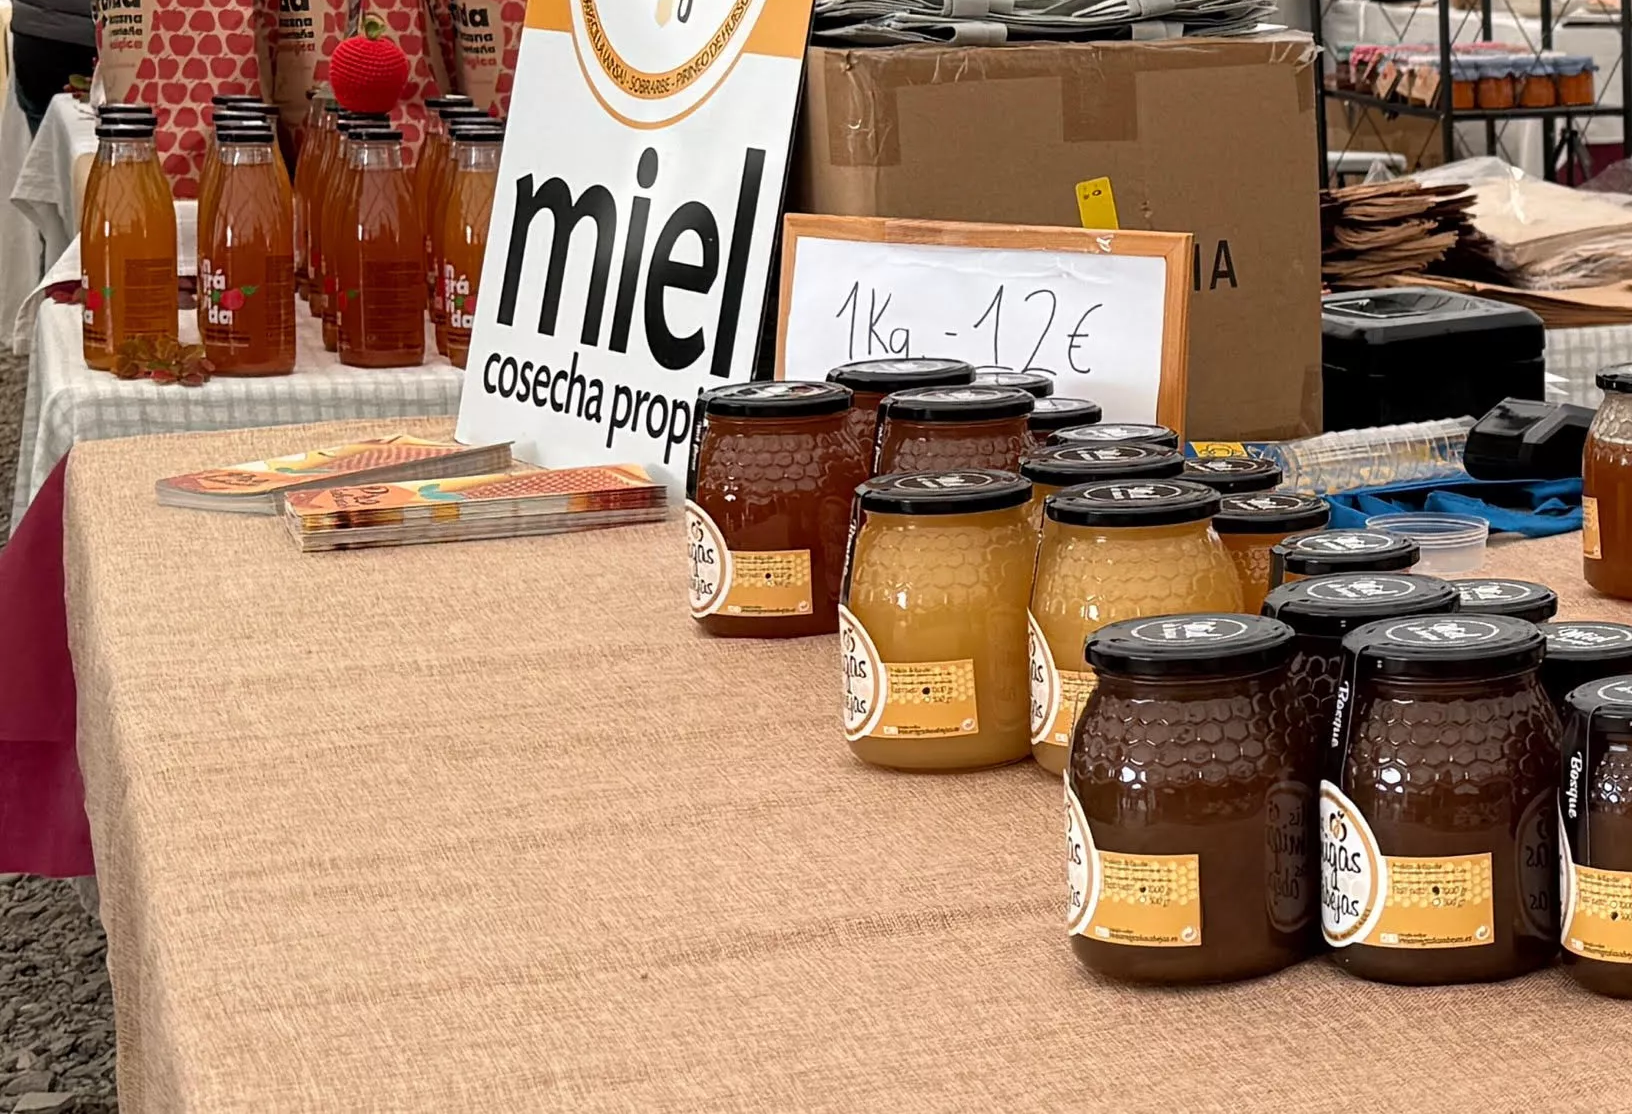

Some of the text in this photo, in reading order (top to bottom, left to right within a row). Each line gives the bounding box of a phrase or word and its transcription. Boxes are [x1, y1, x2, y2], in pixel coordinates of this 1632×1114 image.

[496, 146, 767, 379] miel
[483, 351, 604, 424] cosecha
[1565, 750, 1583, 819] Bosque
